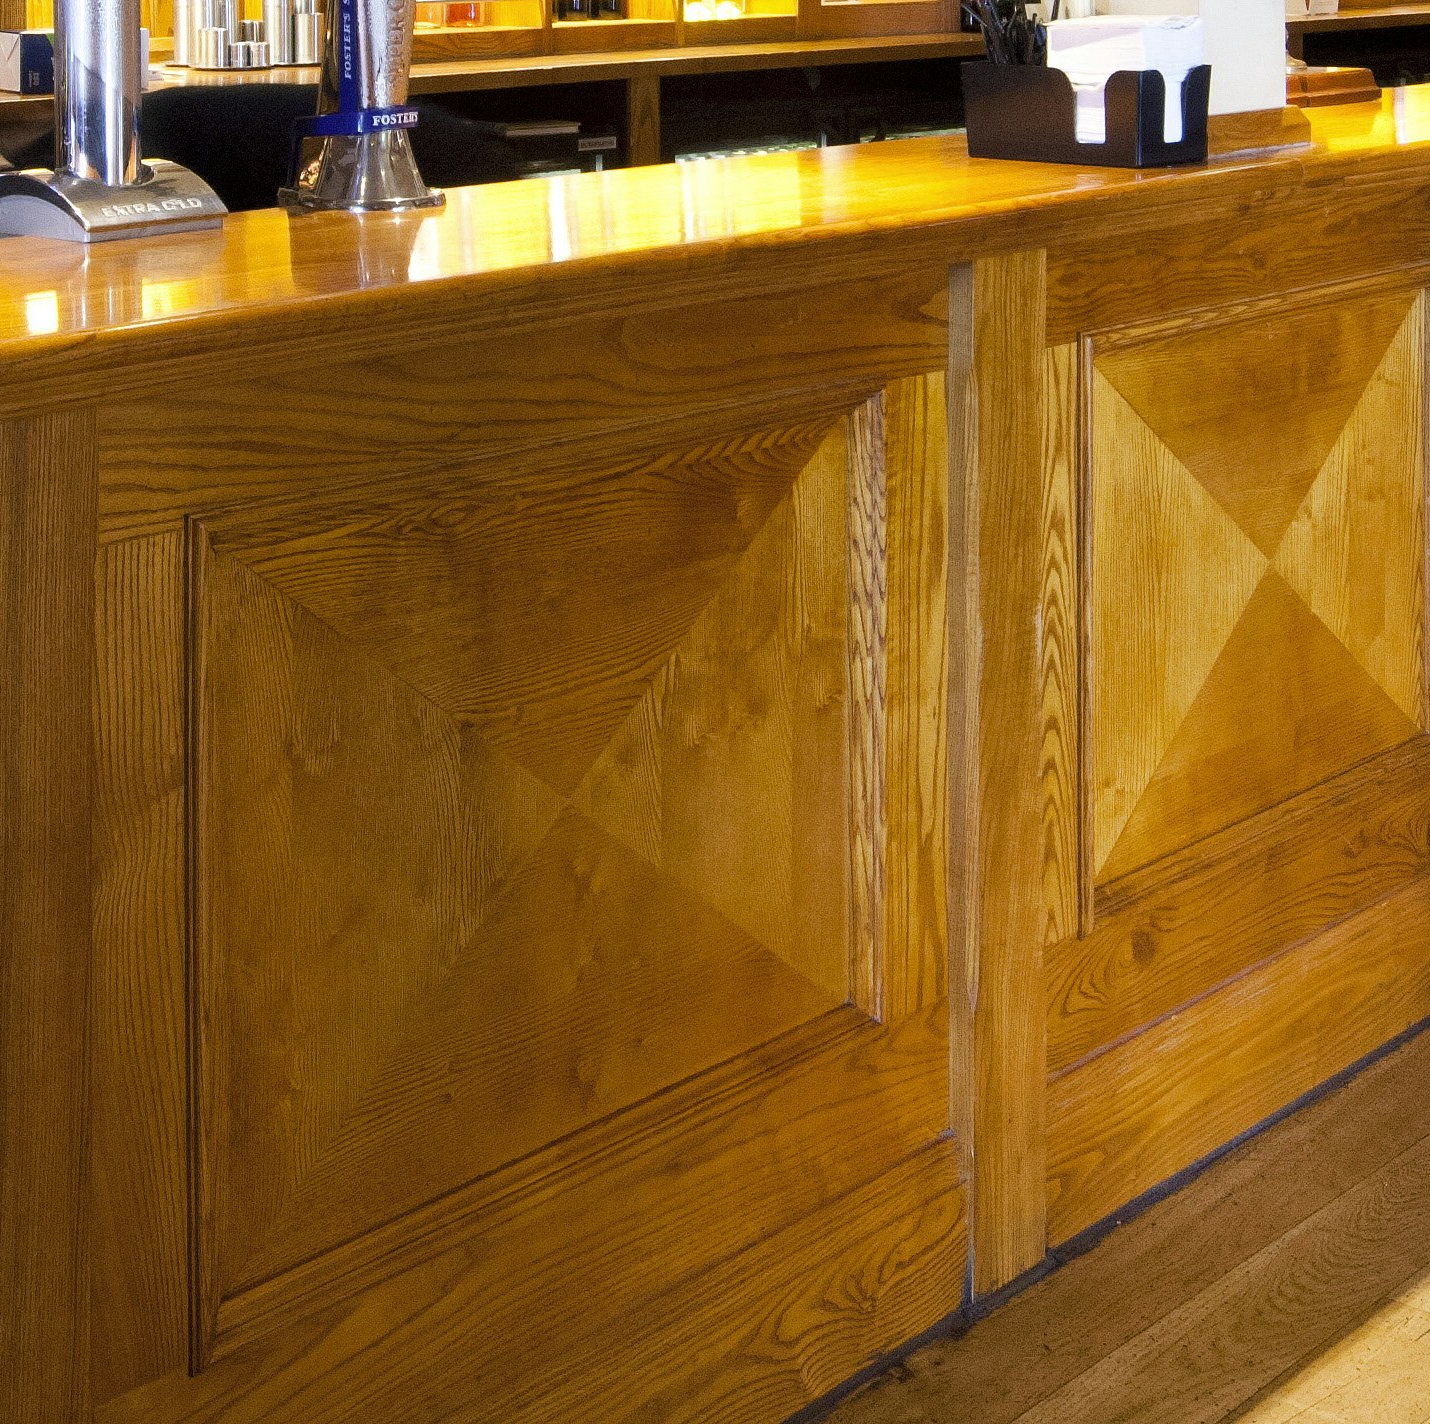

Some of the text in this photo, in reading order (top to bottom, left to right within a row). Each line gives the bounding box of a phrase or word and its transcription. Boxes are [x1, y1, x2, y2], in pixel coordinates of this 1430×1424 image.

[344, 12, 352, 80] FOSTER'S
[372, 111, 419, 126] FOSTER'S
[101, 203, 161, 217] EXTRA
